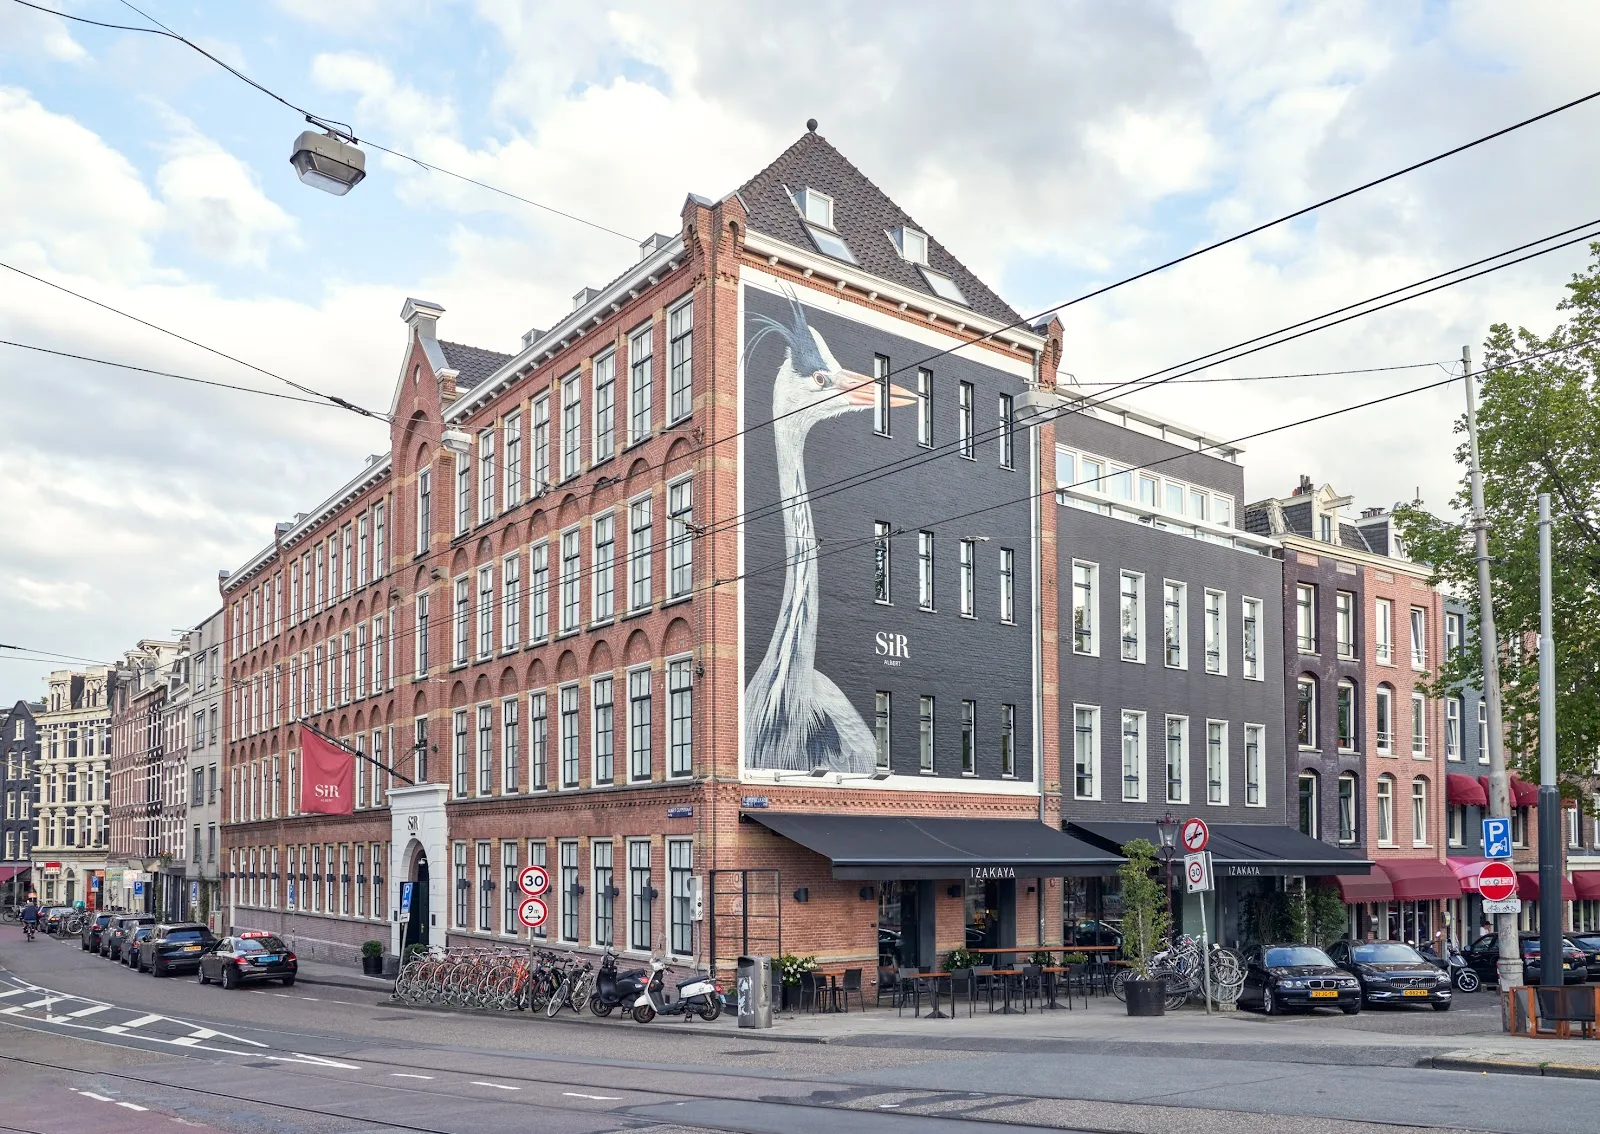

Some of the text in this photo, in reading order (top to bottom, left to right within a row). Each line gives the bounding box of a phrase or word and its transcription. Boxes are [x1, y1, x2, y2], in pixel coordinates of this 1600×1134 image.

[875, 631, 911, 659] SiR
[884, 659, 901, 667] ALBERT
[315, 784, 340, 798] SiR
[1489, 821, 1504, 842] P
[970, 867, 1015, 878] IZAKAYA
[1191, 867, 1200, 878] 30
[1228, 866, 1260, 876] IZAKAYA
[525, 875, 544, 887] 30
